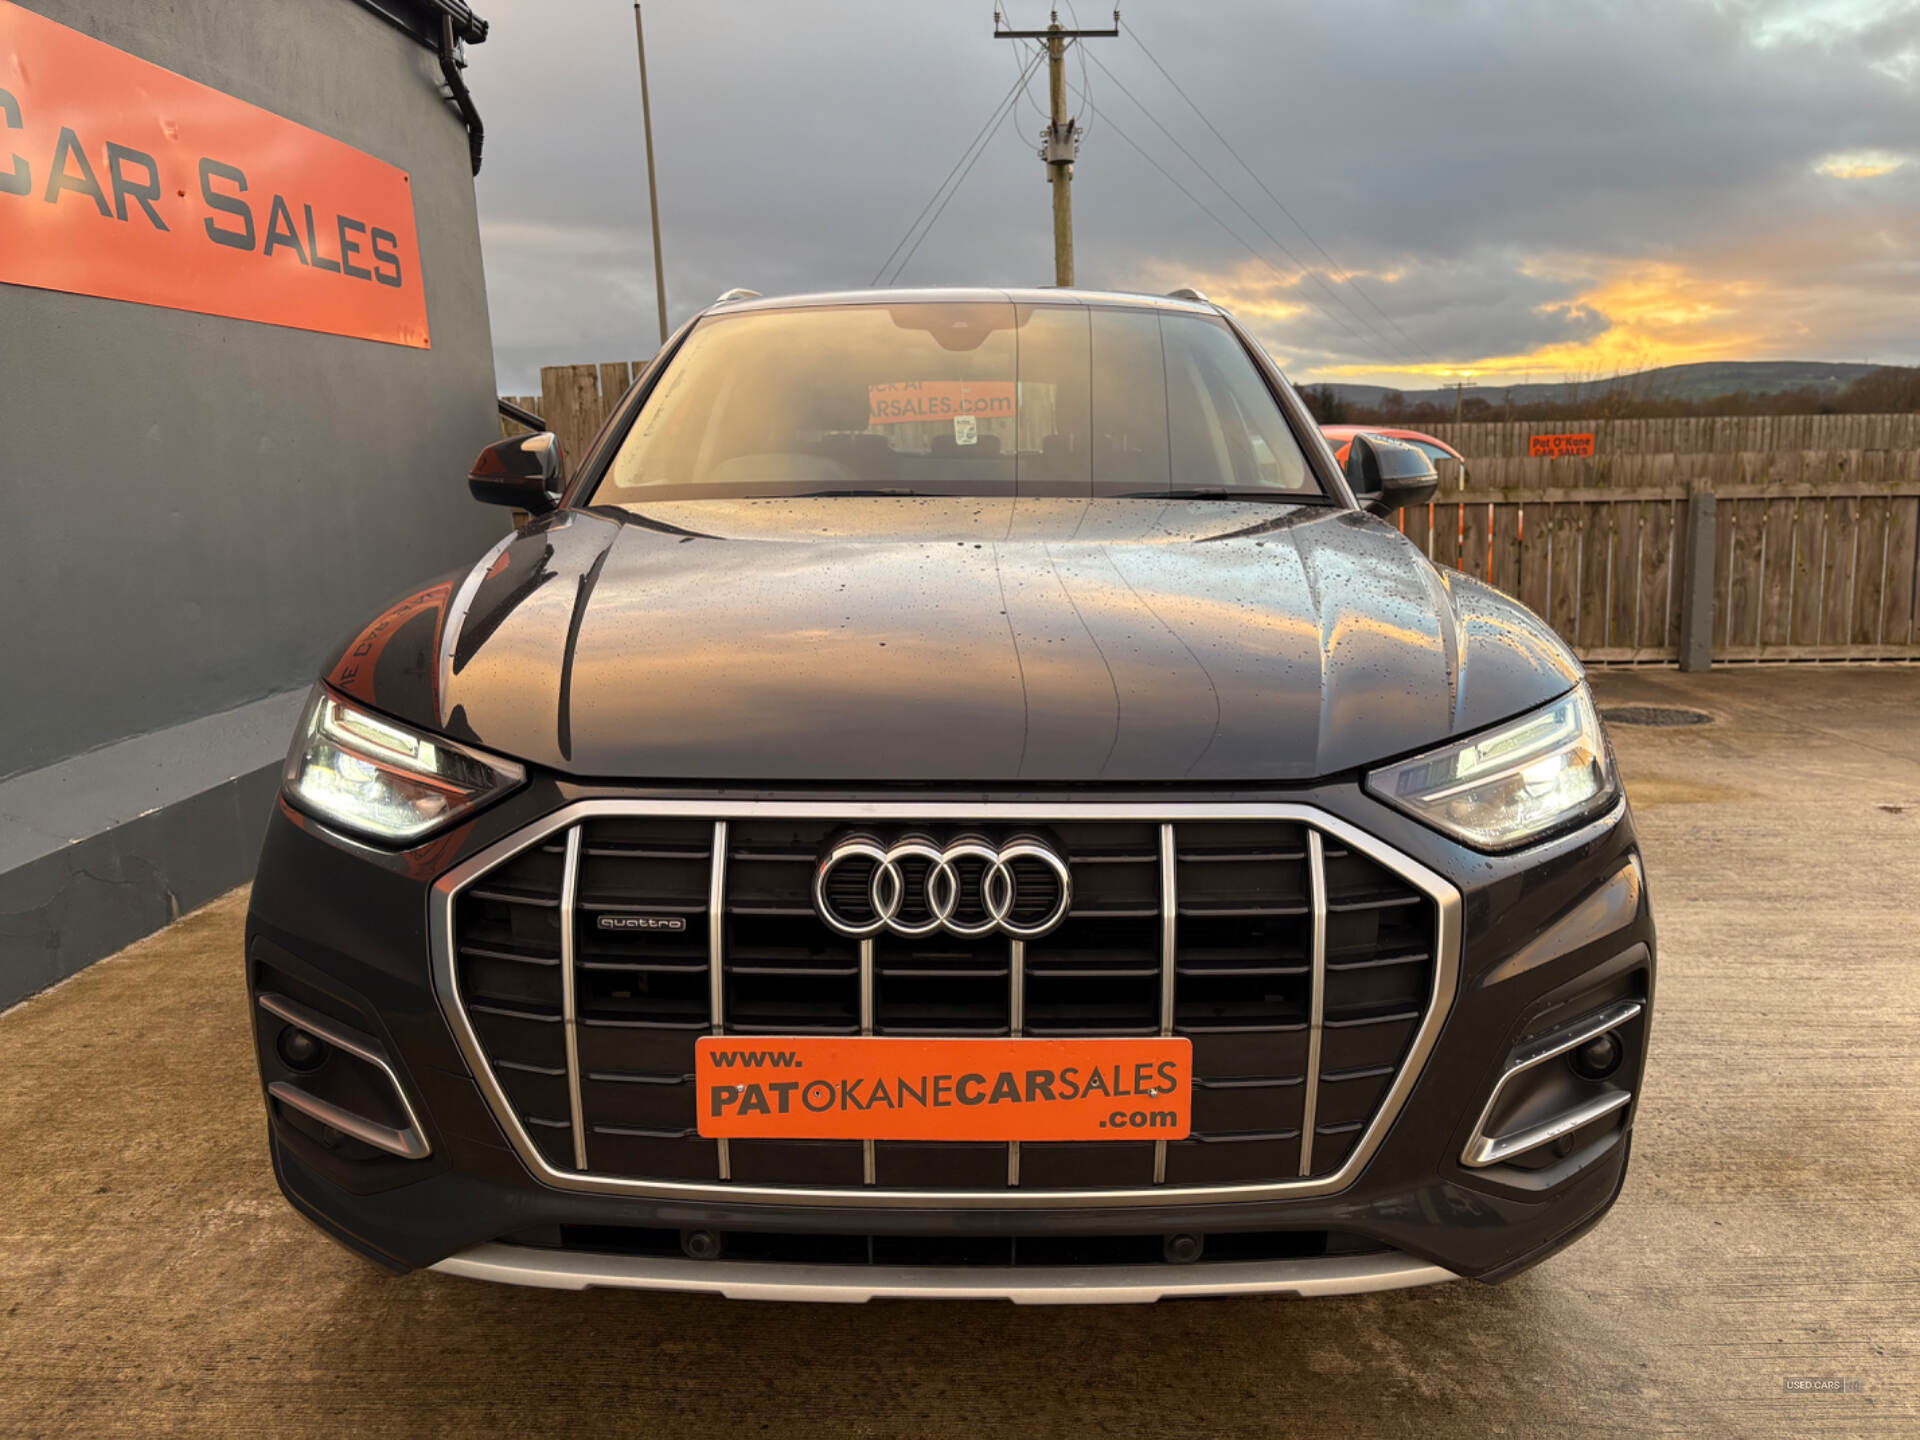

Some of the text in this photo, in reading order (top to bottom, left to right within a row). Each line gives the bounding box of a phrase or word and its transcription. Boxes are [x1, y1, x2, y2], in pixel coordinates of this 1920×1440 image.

[198, 156, 402, 288] SALES
[1533, 438, 1550, 449] Pat
[601, 918, 681, 928] quattro
[710, 1050, 803, 1068] www.
[711, 1060, 1178, 1117] PATOKANECARSALES
[1099, 1109, 1177, 1128] .com
